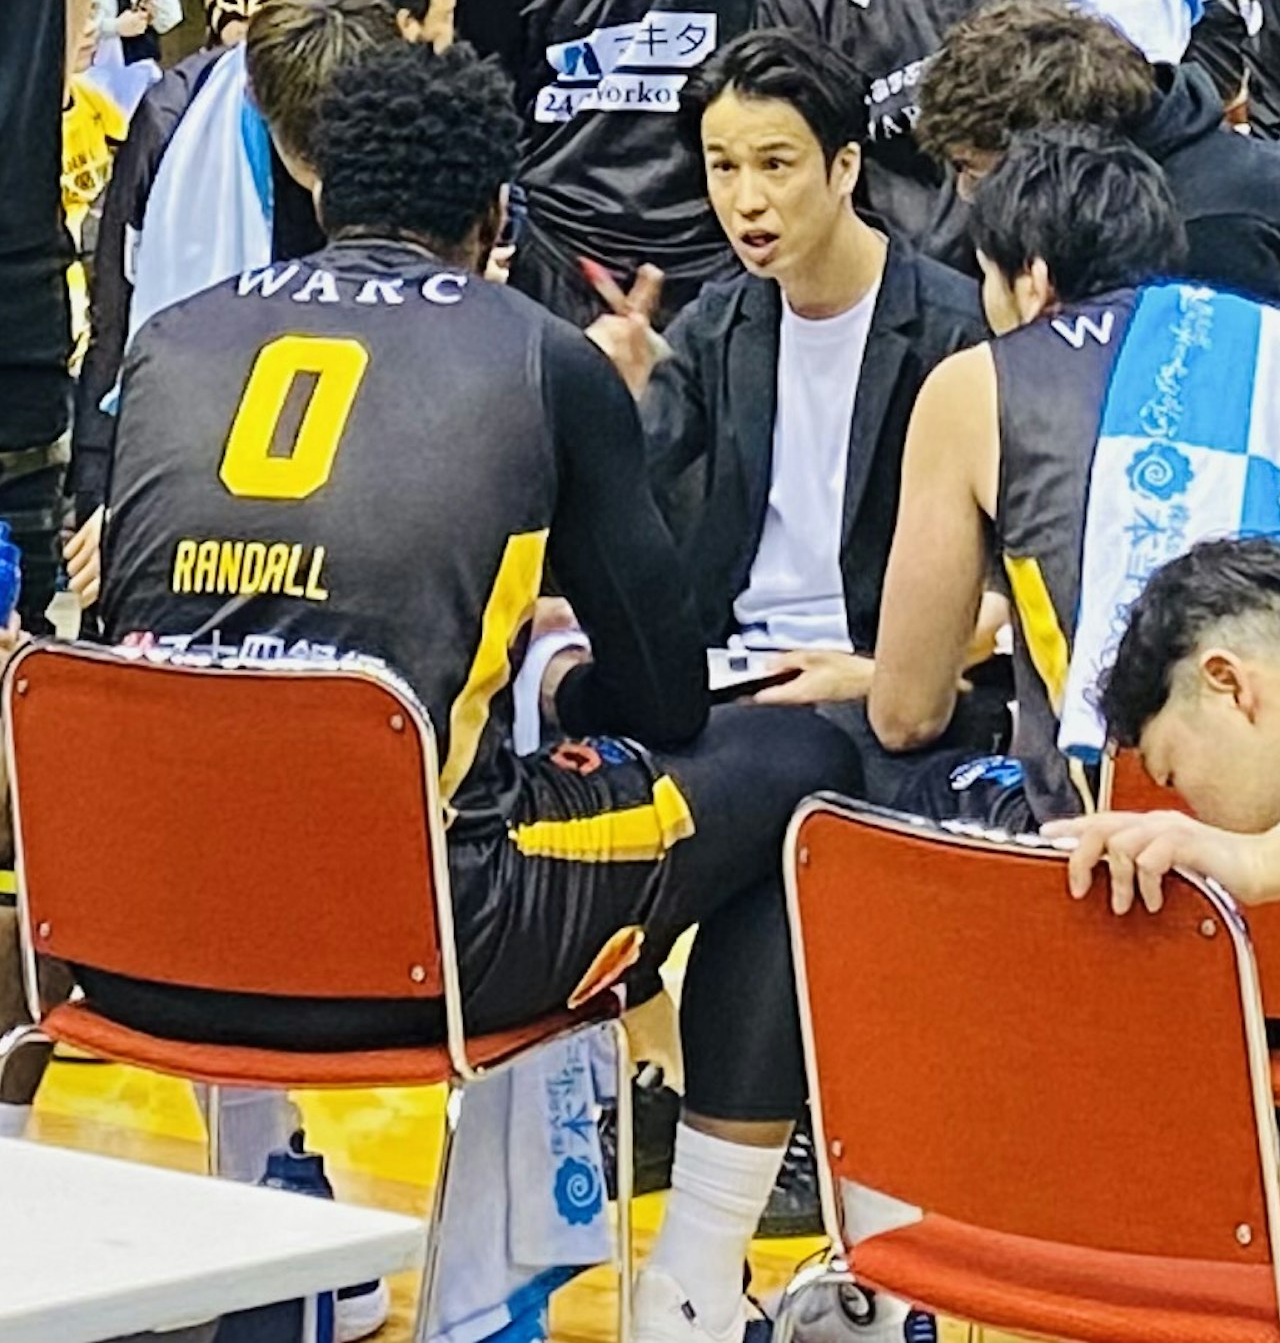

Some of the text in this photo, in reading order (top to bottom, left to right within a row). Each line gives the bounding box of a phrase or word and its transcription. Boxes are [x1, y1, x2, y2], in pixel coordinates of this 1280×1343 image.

[613, 23, 707, 58] キタ
[219, 334, 369, 500] 0
[172, 539, 330, 601] RANDALL
